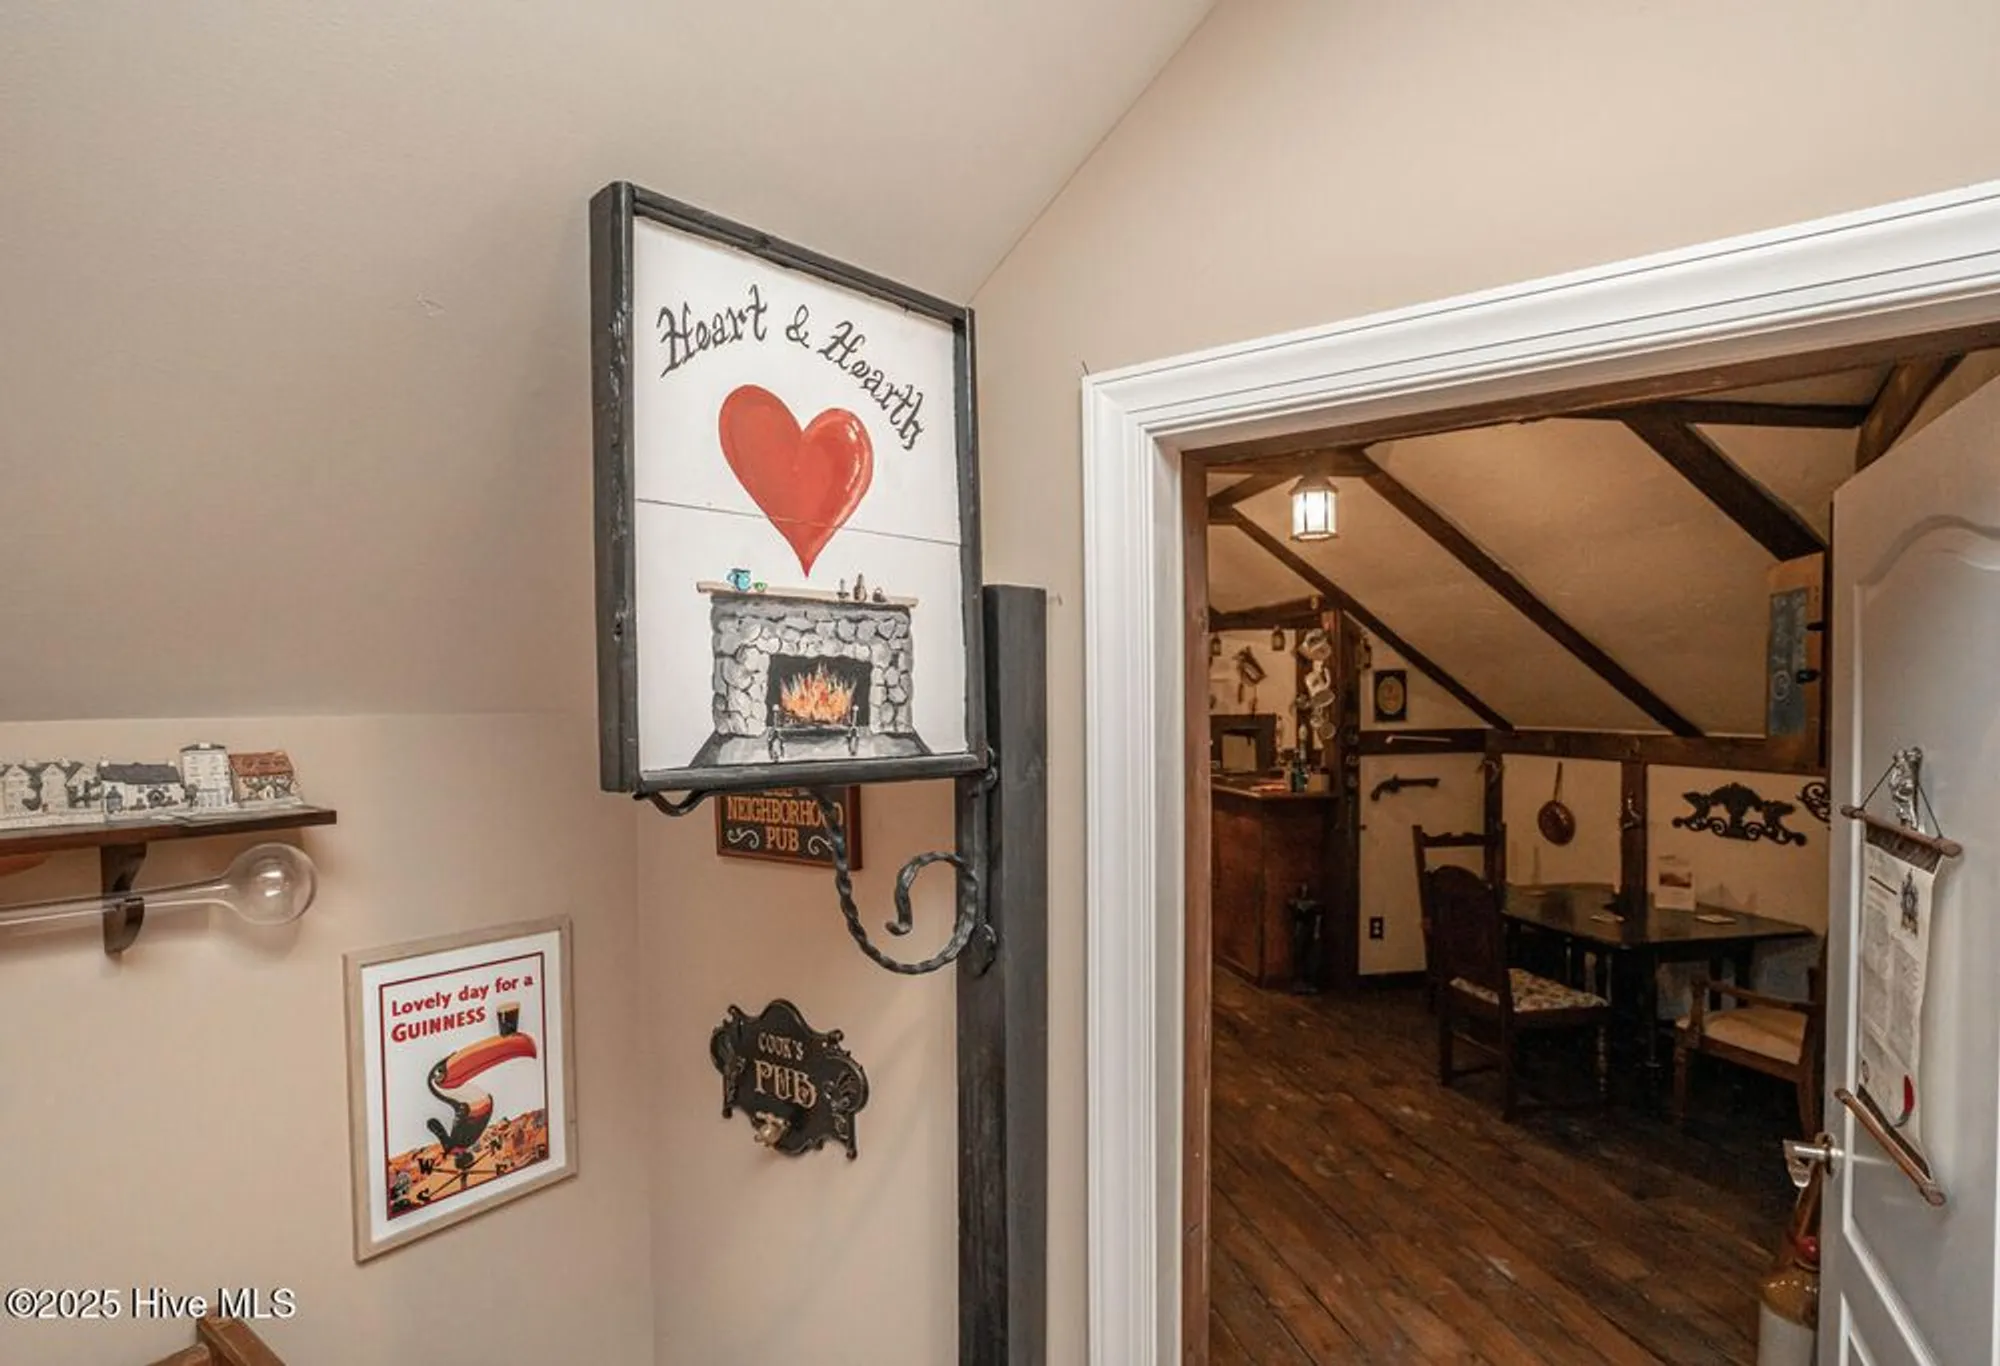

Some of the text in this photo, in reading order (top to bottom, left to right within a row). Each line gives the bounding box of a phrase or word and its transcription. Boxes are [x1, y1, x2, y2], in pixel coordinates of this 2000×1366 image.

[656, 283, 925, 451] Heart & Hearth
[765, 825, 800, 851] PUB
[391, 975, 534, 1018] Lovely day for a
[391, 1006, 487, 1043] GUINNESS
[754, 1059, 817, 1108] PUB
